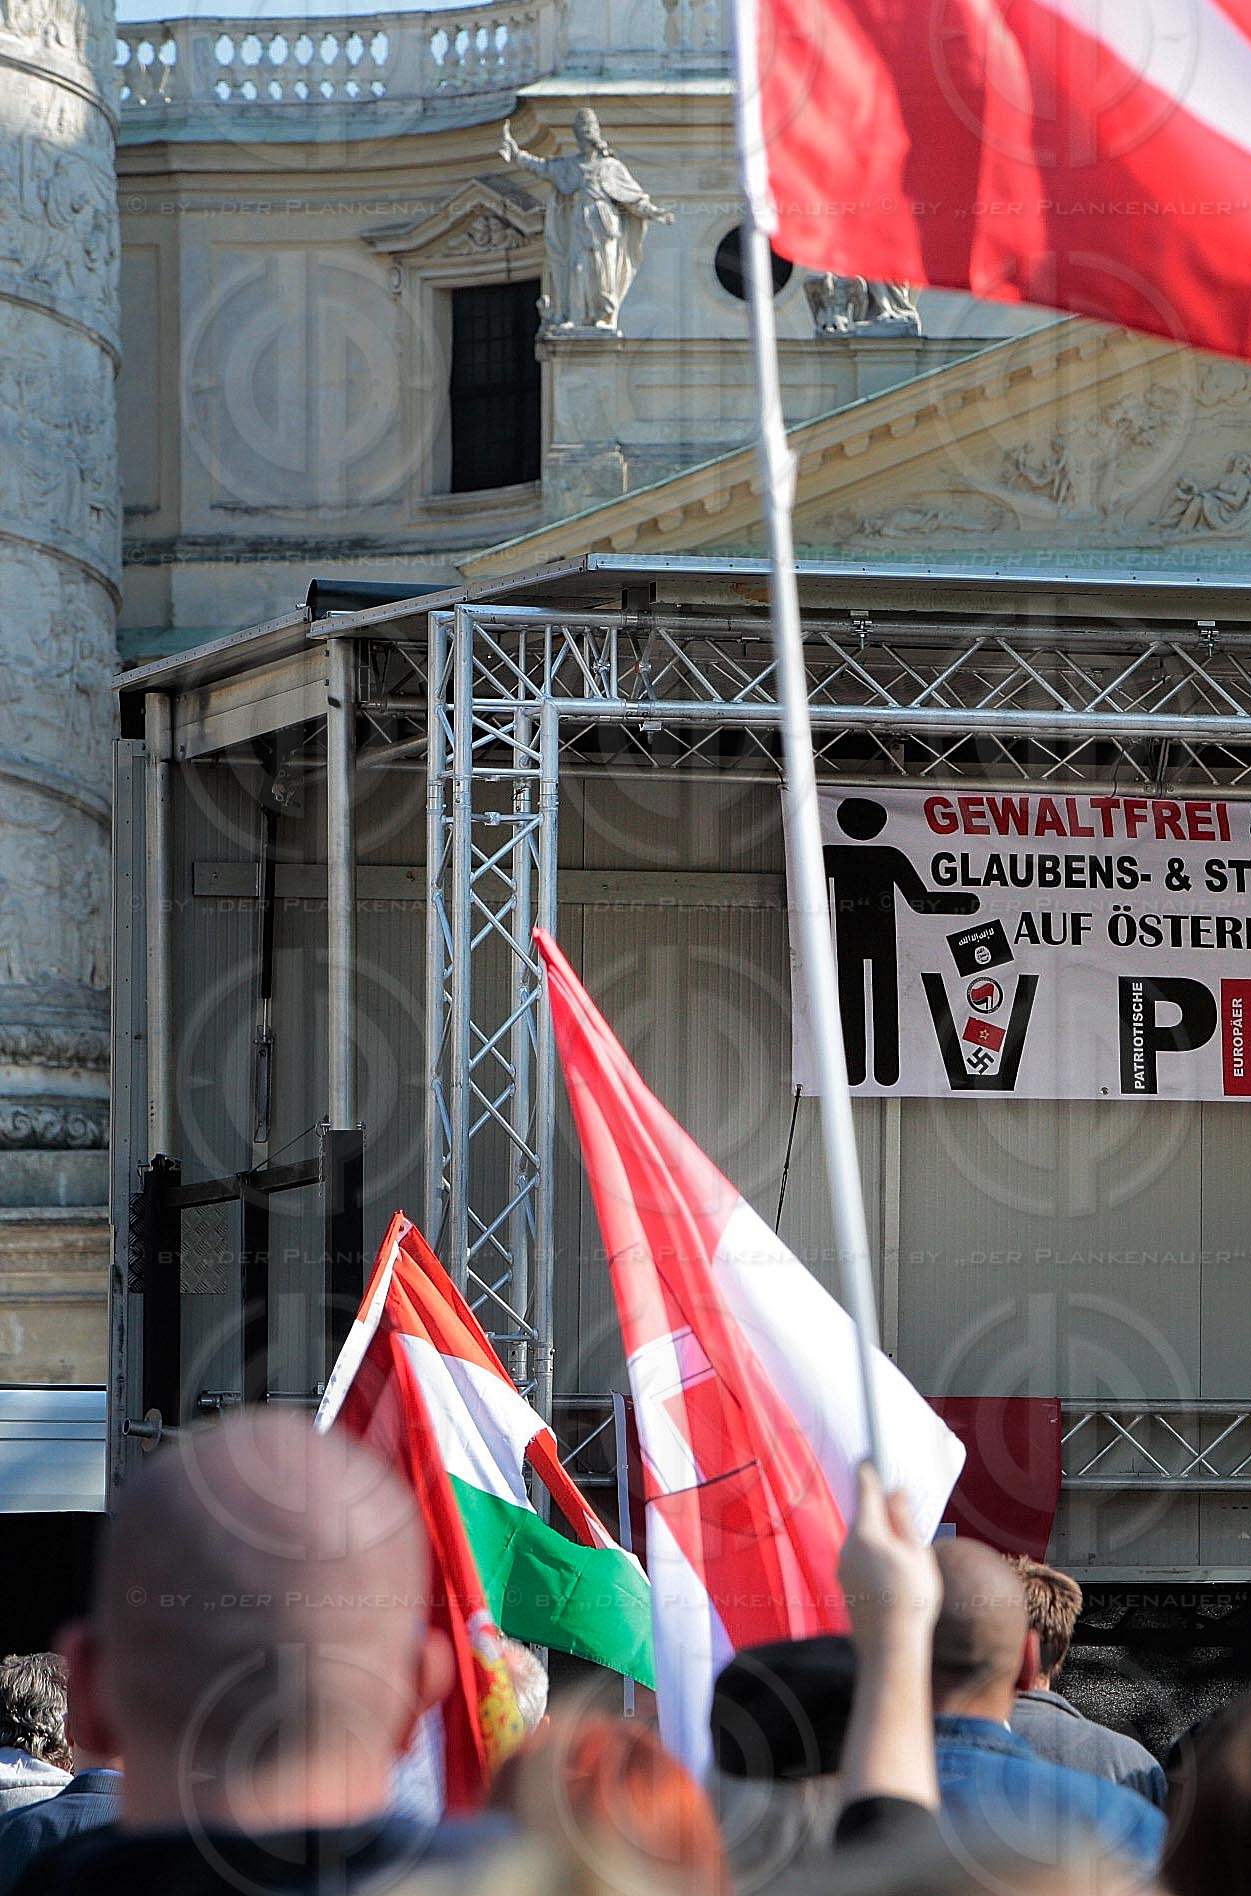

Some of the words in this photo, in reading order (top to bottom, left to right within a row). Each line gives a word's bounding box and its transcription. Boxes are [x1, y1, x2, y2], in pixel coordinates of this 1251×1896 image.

[923, 796, 1231, 842] GEWALTFREI
[930, 852, 1152, 891] GLAUBENS-
[1164, 857, 1192, 892] &
[1013, 911, 1093, 946] AUF
[1132, 981, 1146, 1090] PATRIOTISCHE
[1232, 997, 1244, 1078] EUROPÄER
